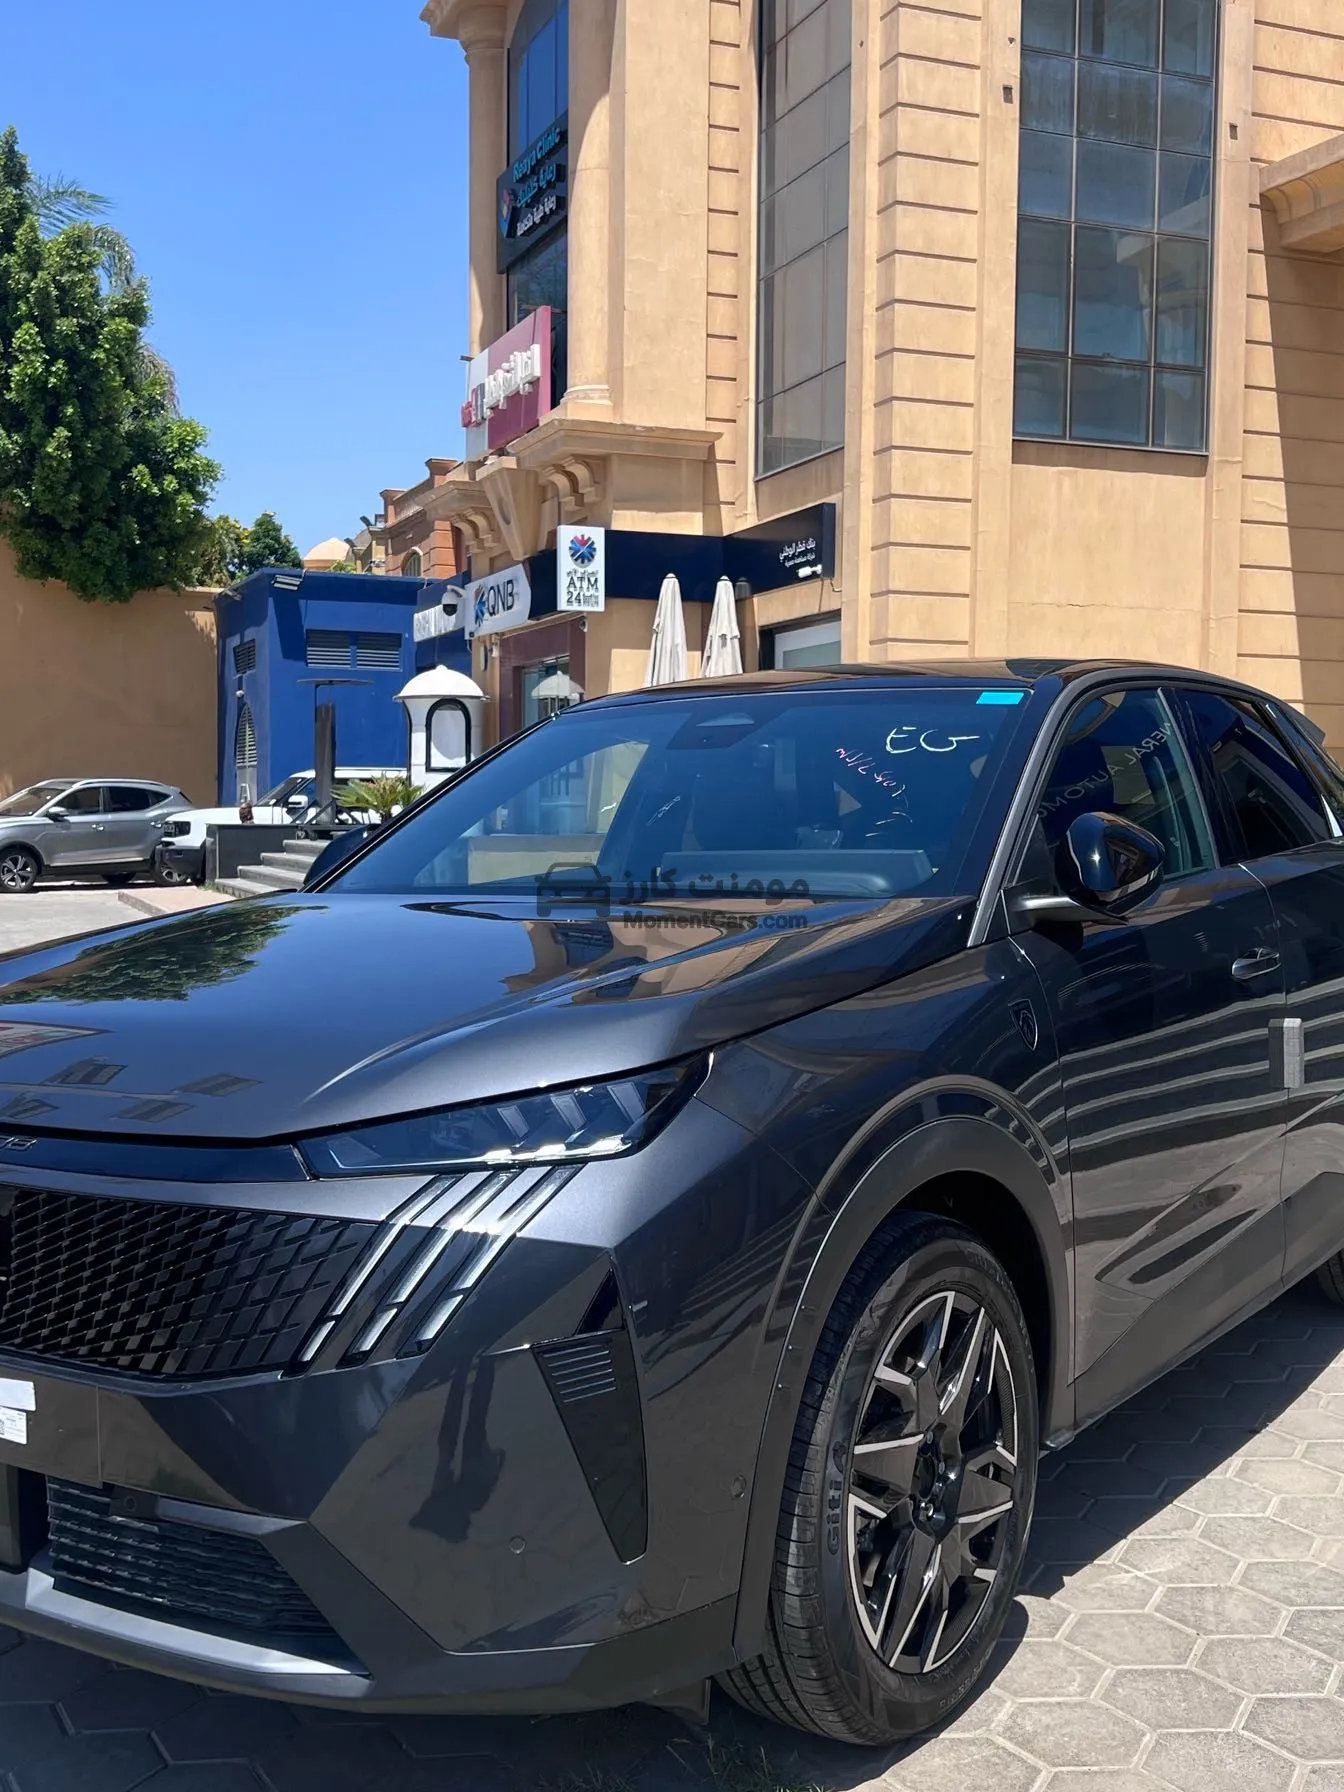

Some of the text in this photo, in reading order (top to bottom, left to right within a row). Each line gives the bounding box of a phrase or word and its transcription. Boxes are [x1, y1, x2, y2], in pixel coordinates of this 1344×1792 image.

[536, 127, 560, 159] Clinic
[779, 537, 816, 563] بنك قطر الوطني
[487, 579, 515, 616] QNB
[567, 576, 599, 590] ATM
[567, 591, 581, 604] 24
[885, 725, 981, 754] EG
[826, 1480, 842, 1556] Giti
